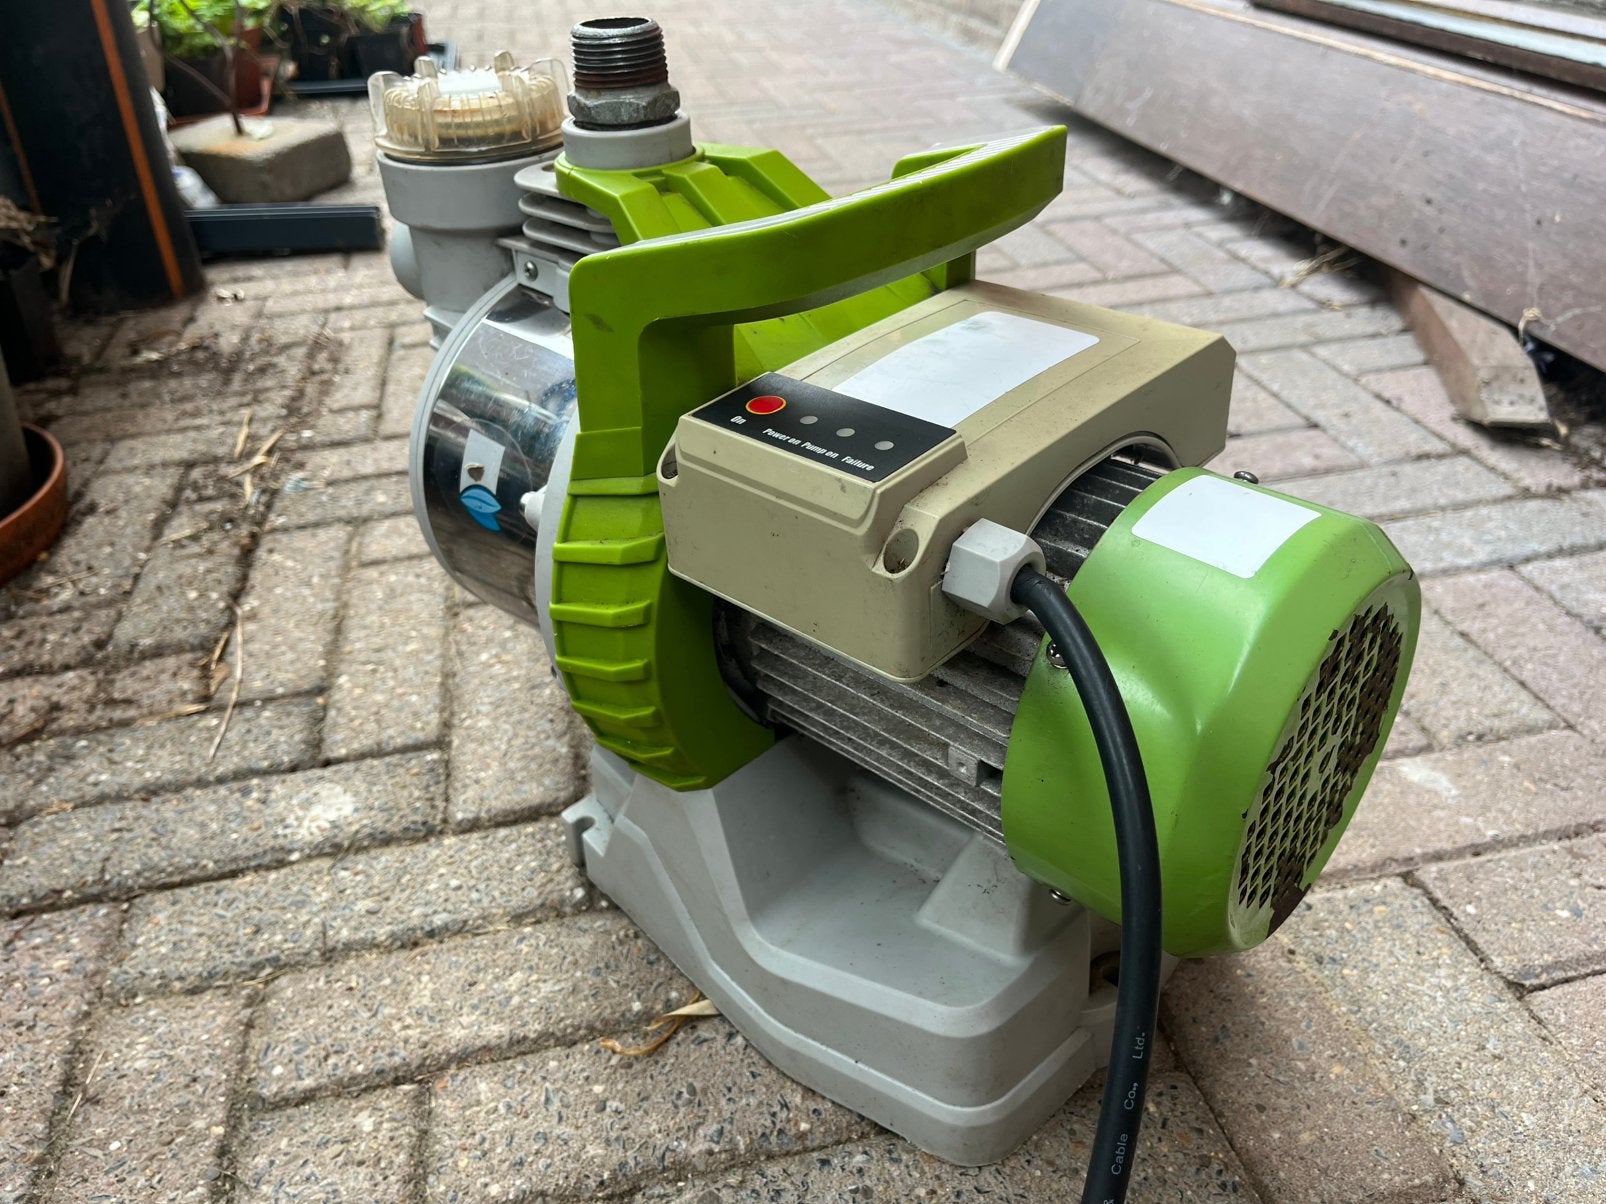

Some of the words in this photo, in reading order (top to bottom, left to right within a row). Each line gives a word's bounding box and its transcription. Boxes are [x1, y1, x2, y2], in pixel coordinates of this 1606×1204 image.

[730, 415, 747, 425] On
[762, 428, 791, 441] Power
[787, 437, 802, 446] on
[801, 441, 828, 455] Pump
[841, 455, 875, 471] Failure
[1111, 1133, 1129, 1175] Cable
[1123, 1082, 1139, 1110] Co.,
[1132, 1031, 1146, 1060] Ltd.
